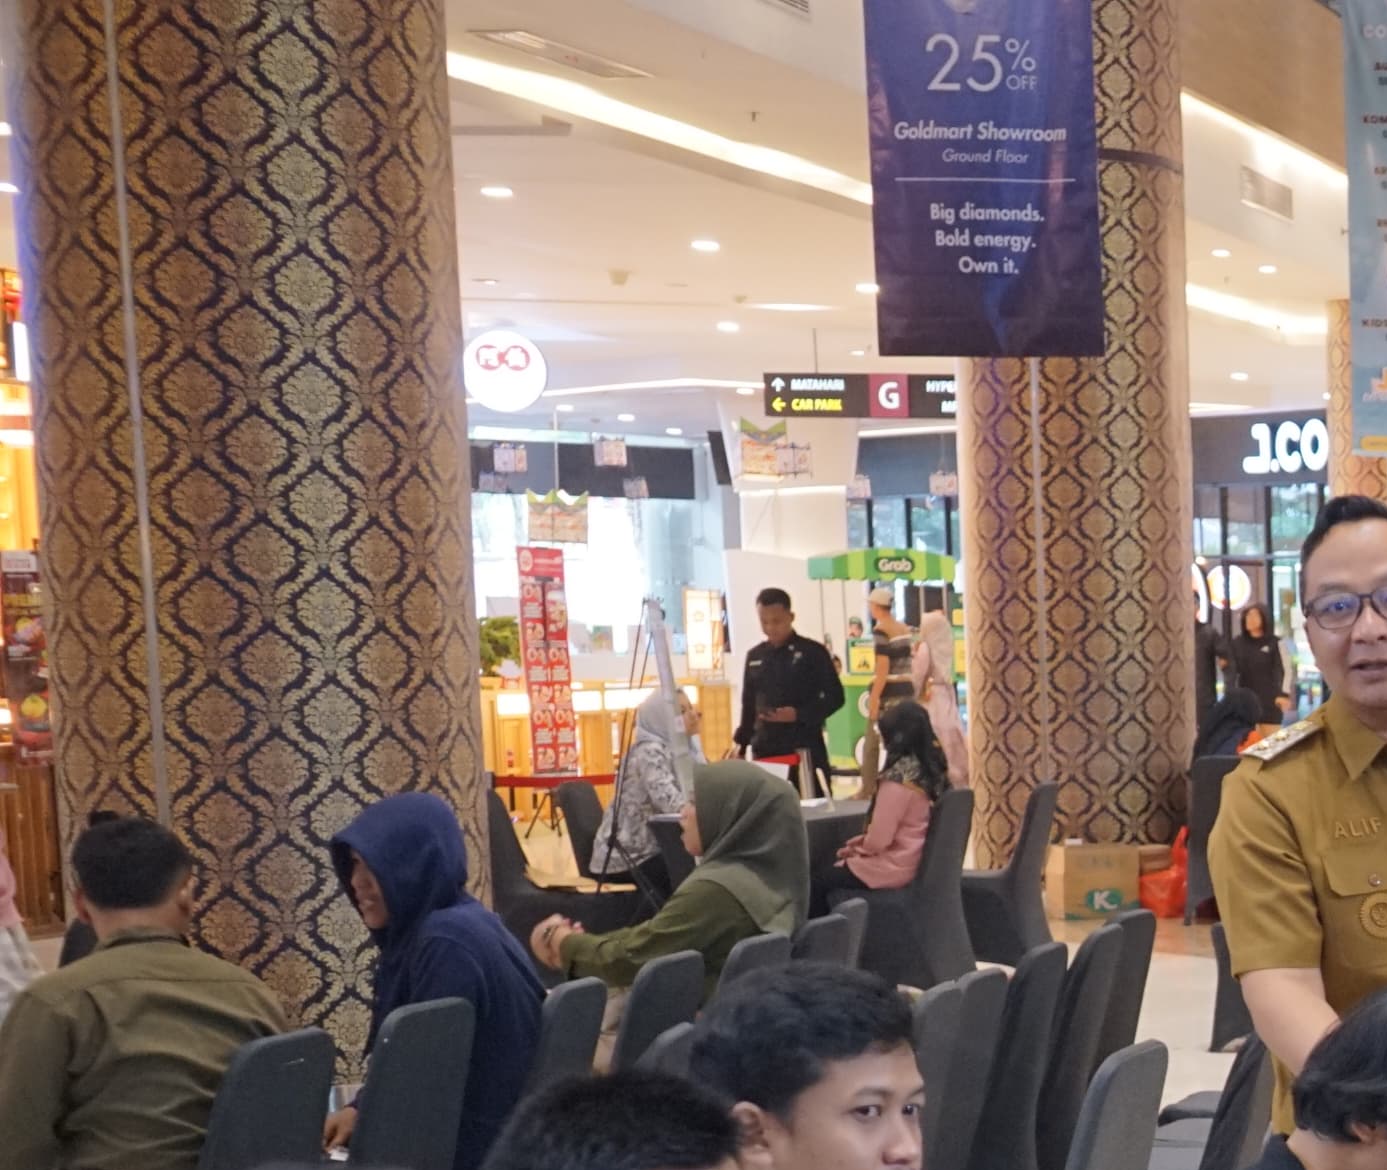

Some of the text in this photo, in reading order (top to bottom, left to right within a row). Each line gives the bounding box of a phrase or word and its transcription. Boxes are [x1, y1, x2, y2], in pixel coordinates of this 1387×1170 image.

[1006, 76, 1037, 90] OFF
[894, 121, 1067, 142] Goldmart Showroom
[942, 148, 1029, 164] Ground Floor
[930, 203, 1045, 224] Big diamonds.
[935, 230, 1037, 251] Bold energy.
[958, 257, 1020, 274] Own it.
[791, 398, 842, 411] CAR PARK
[878, 381, 899, 409] G
[878, 558, 912, 572] Grab
[1334, 817, 1382, 839] ALIF
